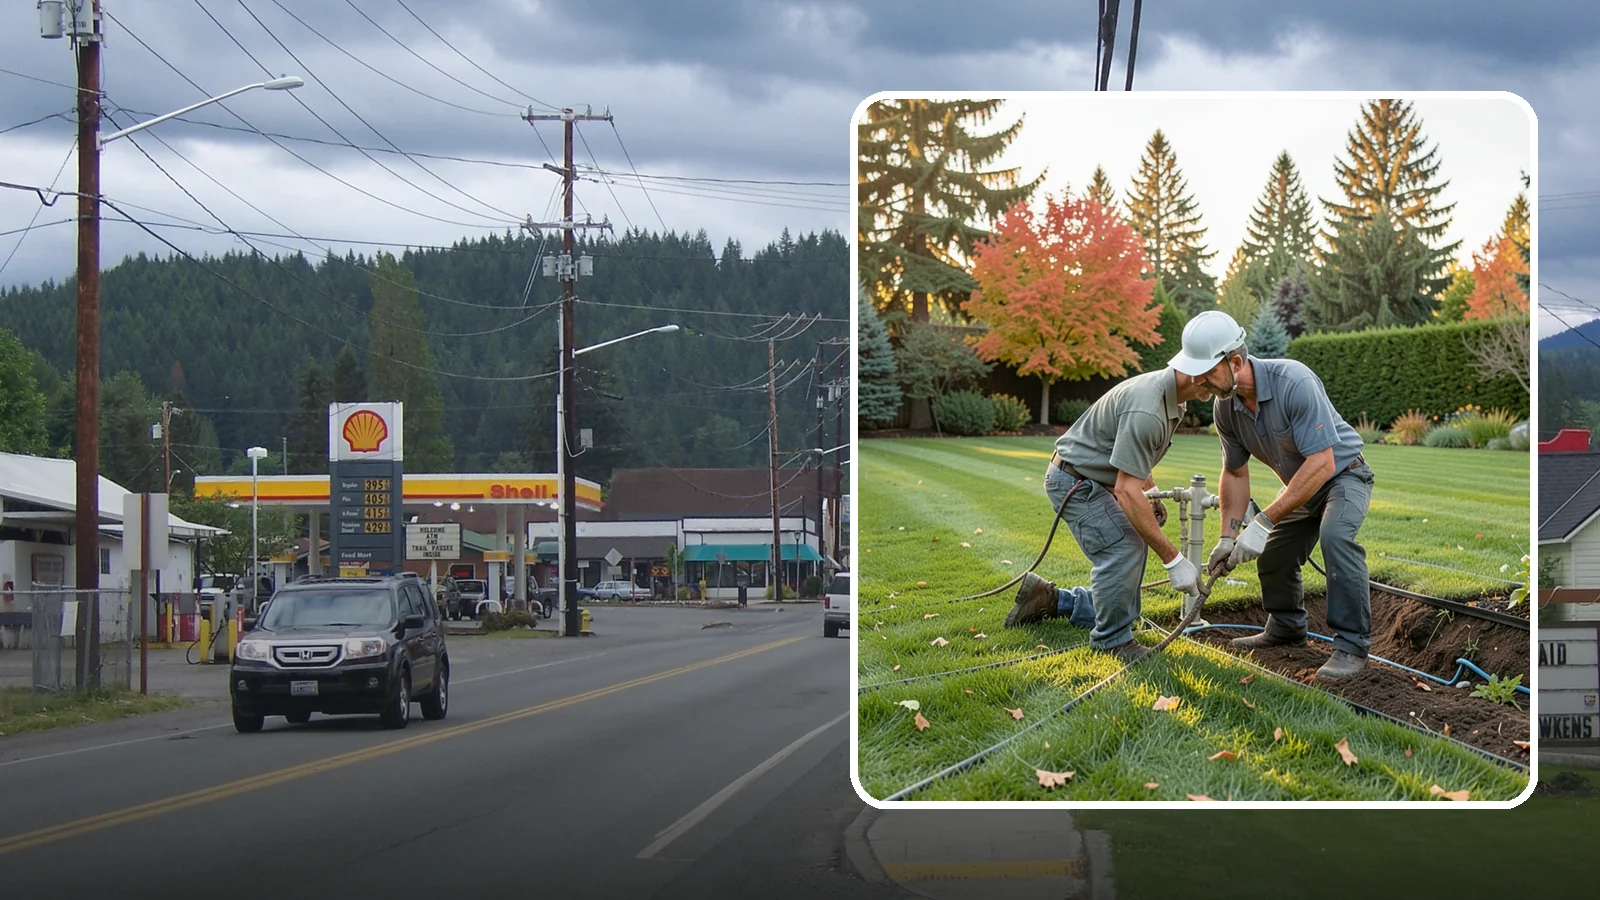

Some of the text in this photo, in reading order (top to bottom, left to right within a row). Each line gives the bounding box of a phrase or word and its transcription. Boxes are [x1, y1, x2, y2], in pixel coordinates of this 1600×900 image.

[366, 480, 383, 490] 395
[490, 484, 547, 499] Shell
[366, 494, 383, 504] 405
[366, 508, 383, 518] 415
[366, 522, 383, 532] 429
